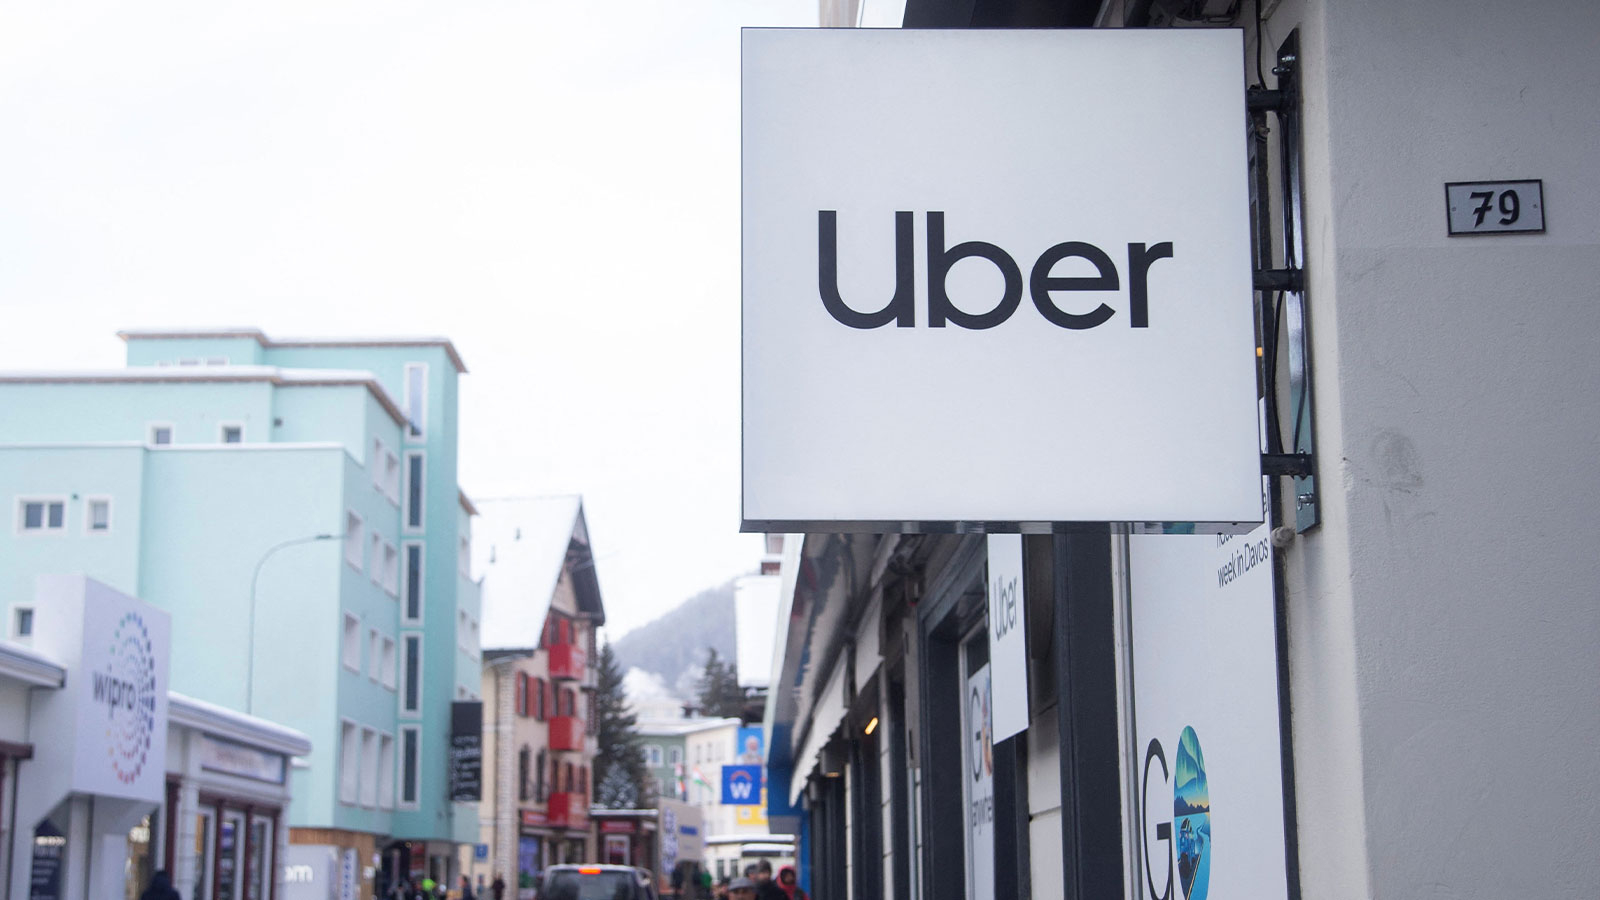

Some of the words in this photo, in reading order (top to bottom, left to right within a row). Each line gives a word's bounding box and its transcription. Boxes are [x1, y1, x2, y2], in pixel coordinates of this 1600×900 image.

[1469, 189, 1520, 228] 79
[818, 210, 1173, 330] Uber
[1217, 552, 1236, 588] week
[1236, 549, 1245, 577] in
[1244, 537, 1269, 573] Davos
[994, 575, 1018, 642] Uber
[93, 662, 136, 720] wipro
